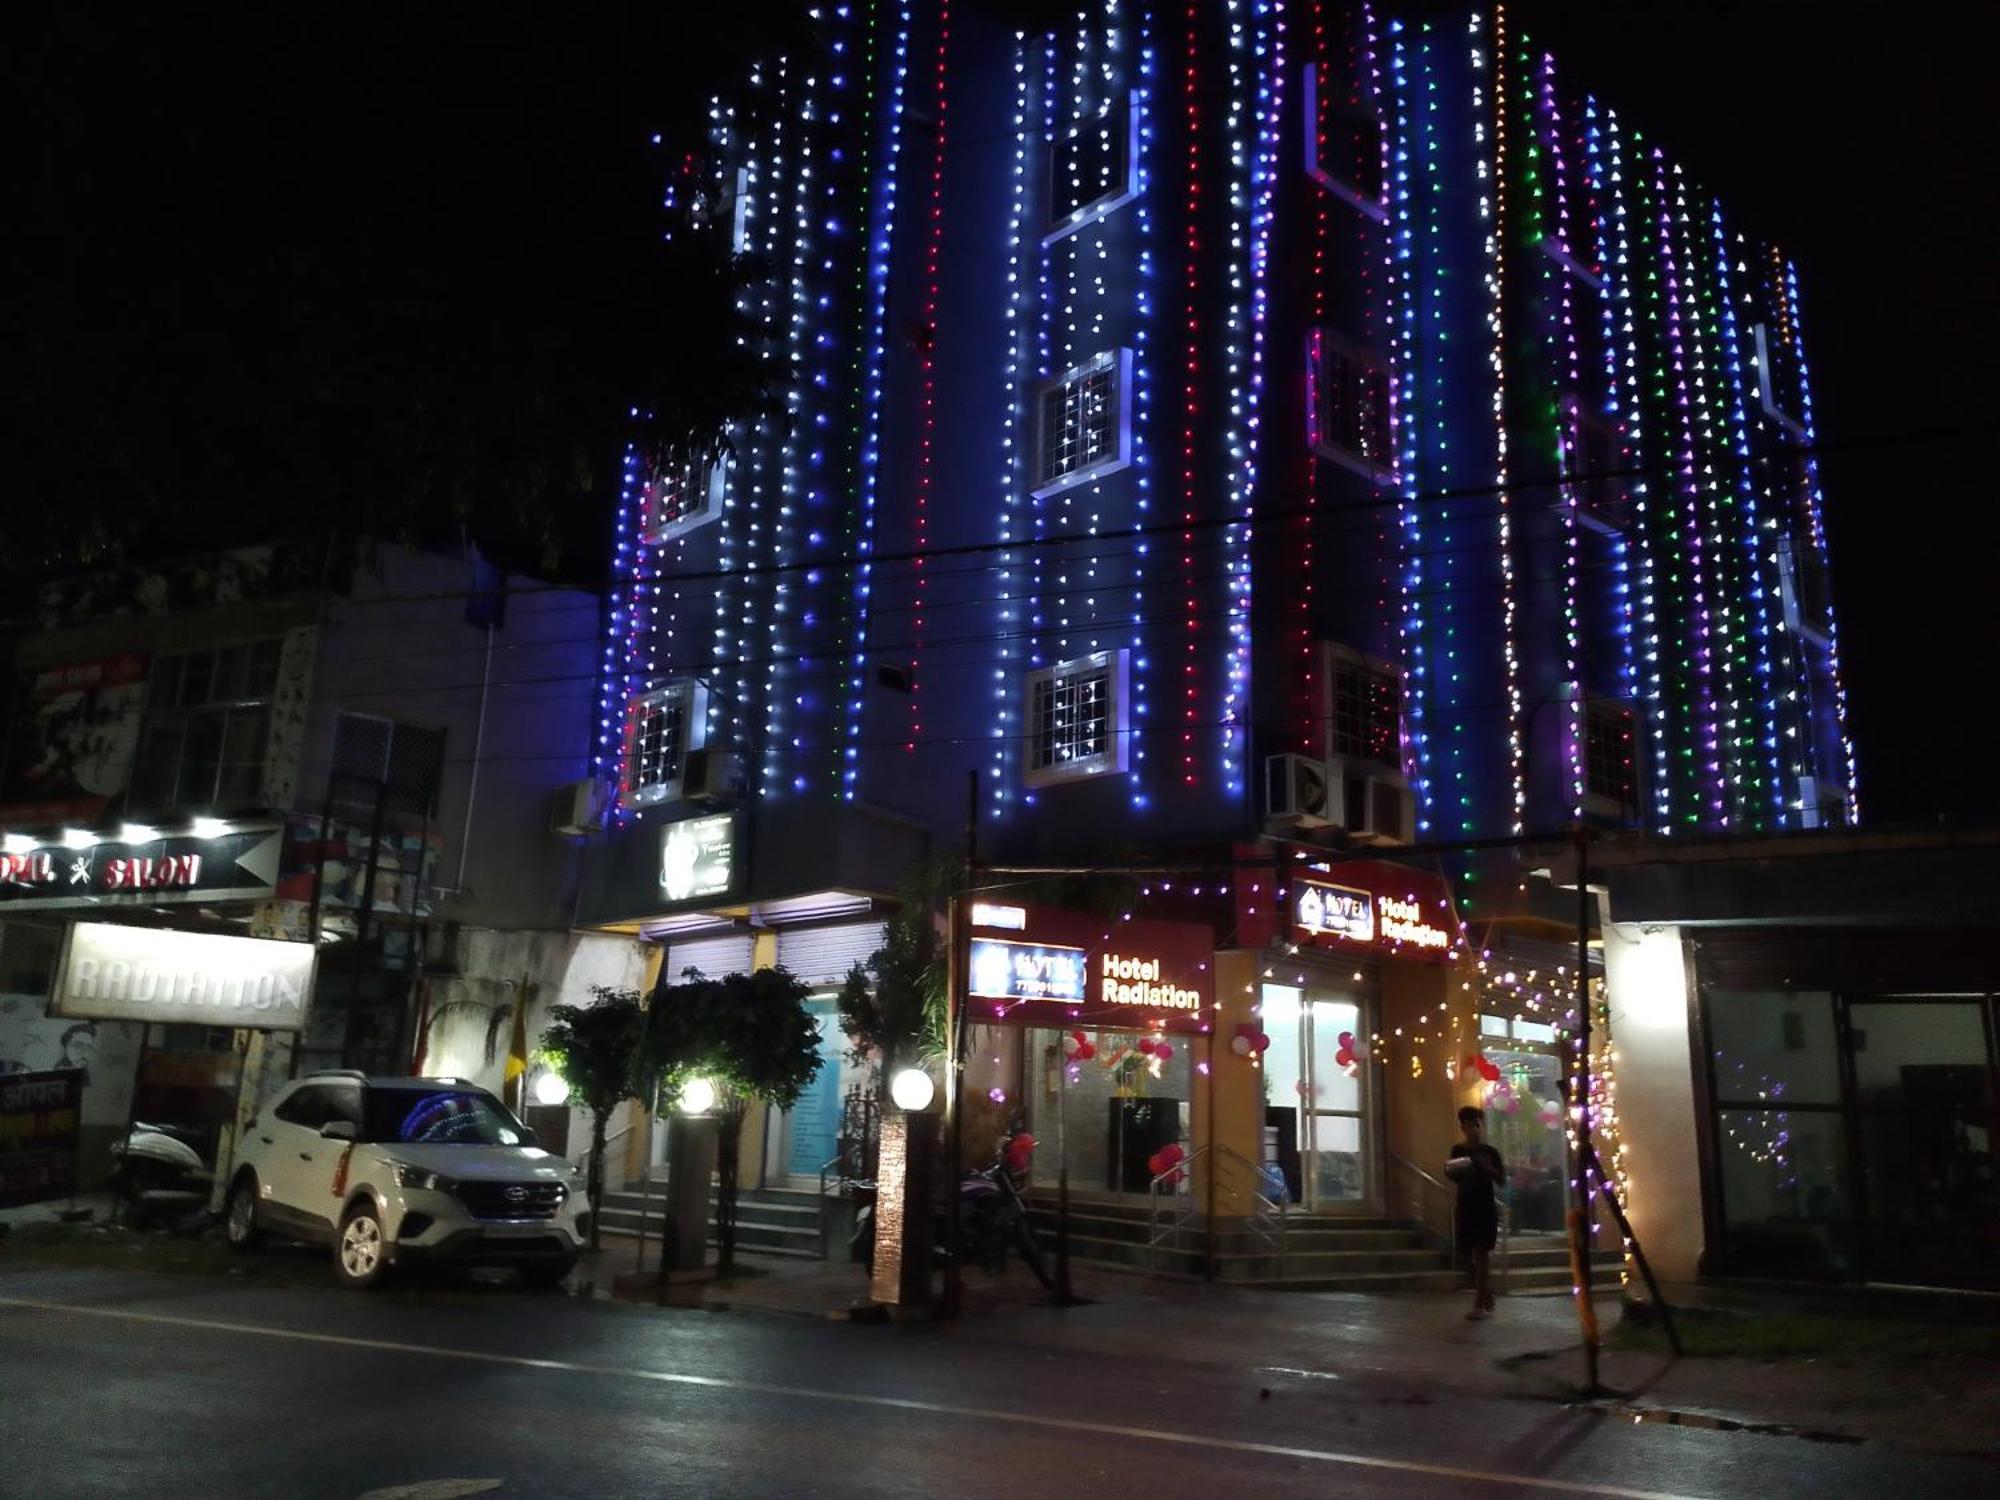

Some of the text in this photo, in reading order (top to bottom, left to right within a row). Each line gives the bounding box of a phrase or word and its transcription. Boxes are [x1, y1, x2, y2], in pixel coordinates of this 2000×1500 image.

[105, 854, 201, 888] SALON
[1380, 896, 1420, 922] Hotel
[1102, 953, 1160, 981] Hotel
[1101, 978, 1201, 1010] Radiation
